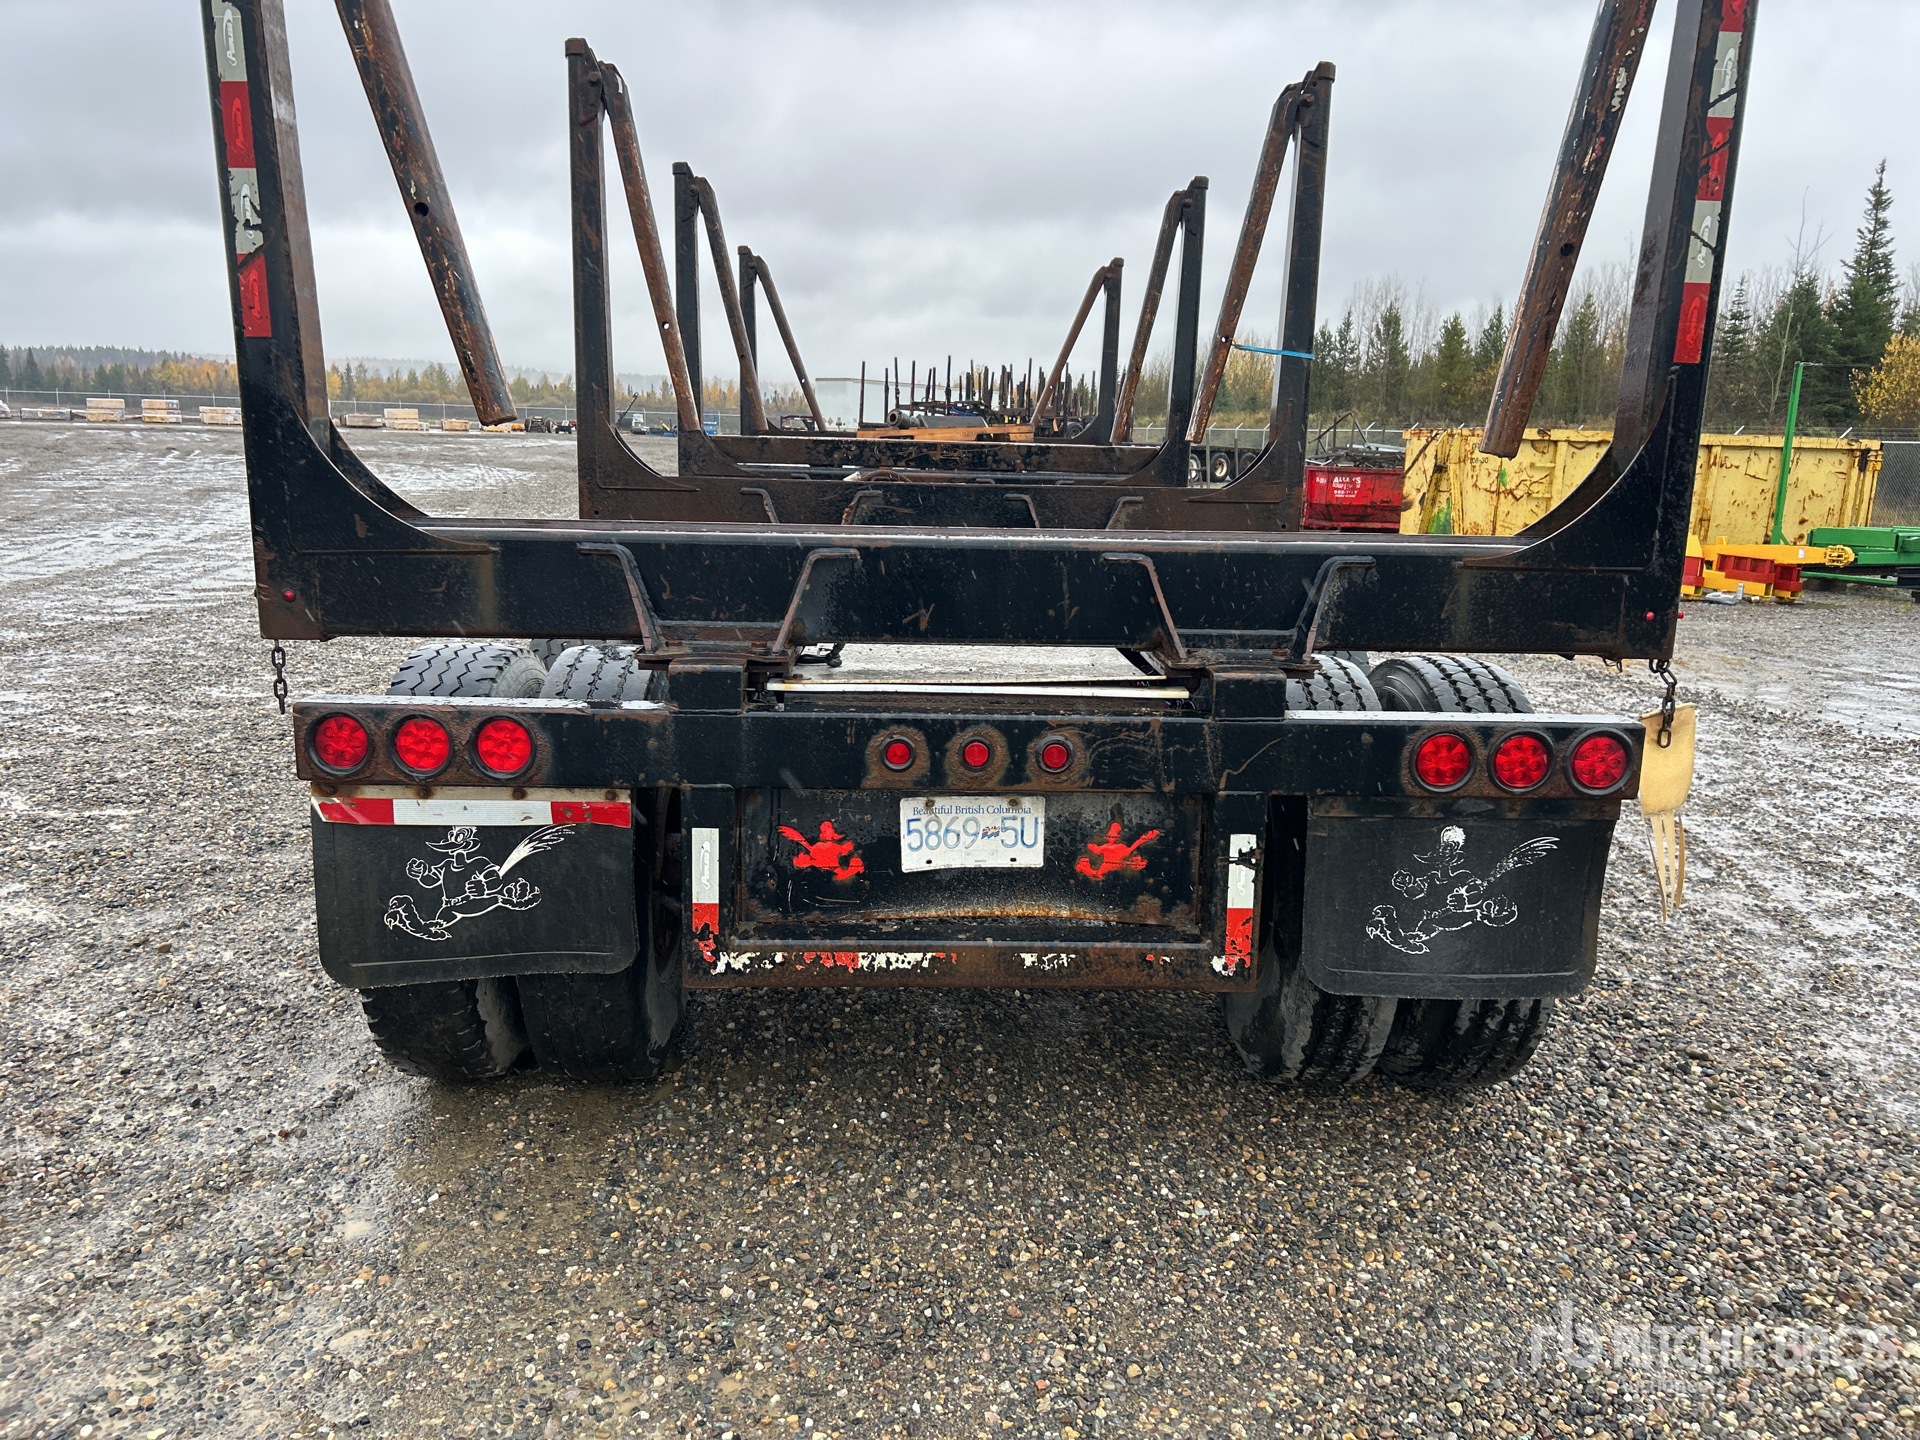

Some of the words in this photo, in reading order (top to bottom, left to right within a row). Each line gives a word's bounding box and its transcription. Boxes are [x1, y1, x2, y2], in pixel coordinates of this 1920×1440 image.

[955, 805, 985, 815] British
[986, 804, 1032, 815] Columbia
[906, 816, 981, 852] 5869
[1000, 815, 1039, 849] 5U
